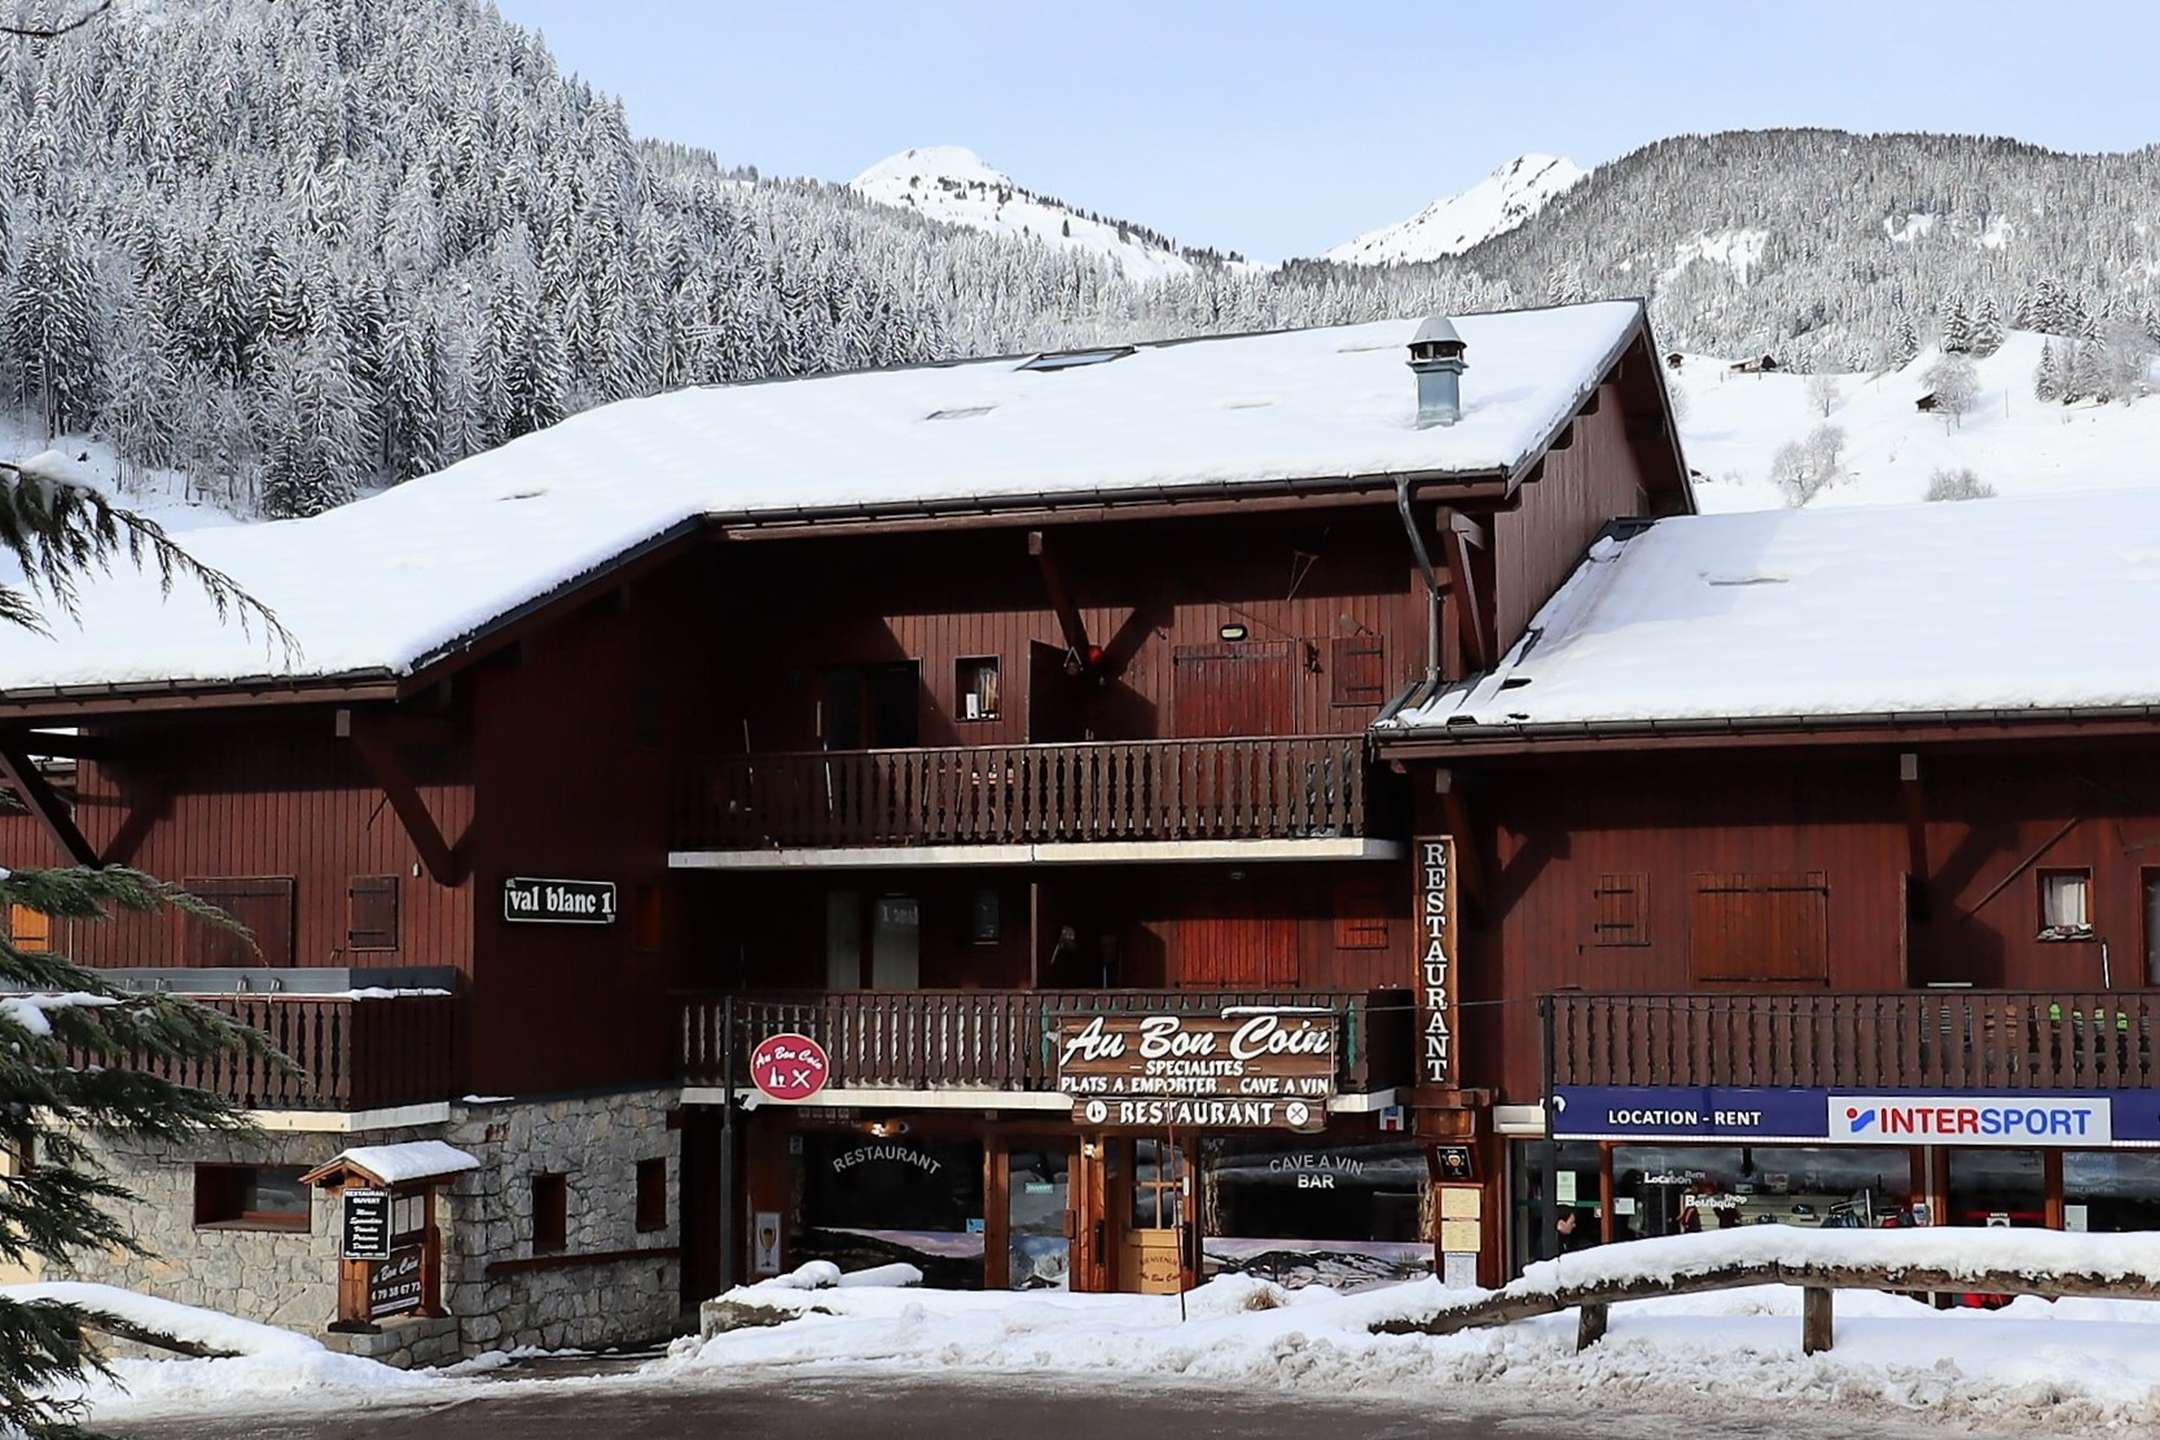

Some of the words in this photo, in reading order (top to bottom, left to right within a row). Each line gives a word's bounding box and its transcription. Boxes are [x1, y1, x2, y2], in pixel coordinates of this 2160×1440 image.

[509, 886, 539, 911] val
[545, 886, 596, 913] blanc
[602, 892, 612, 913] 1
[1423, 843, 1449, 1082] RESTAURANT
[1060, 1016, 1126, 1066] Au
[1140, 1016, 1217, 1059] Bon
[1229, 1015, 1330, 1060] Coin
[756, 1052, 771, 1069] Au
[775, 1046, 796, 1060] Bon
[1145, 1060, 1244, 1076] SPECIALITES
[1060, 1077, 1108, 1092] PLATS
[1112, 1077, 1124, 1093] A
[1131, 1077, 1217, 1093] EMPORTER
[1240, 1078, 1279, 1094] CAVE
[1284, 1078, 1295, 1094] A
[1300, 1078, 1329, 1094] VIN
[1120, 1101, 1275, 1125] RESTAURANT
[1608, 1110, 1697, 1125] LOCATION
[1714, 1111, 1762, 1126] RENT
[1881, 1107, 2092, 1135] INTERSPORT
[832, 1145, 942, 1174] RESTAURANT
[1270, 1154, 1314, 1173] CAVE
[1319, 1155, 1330, 1168] A
[1336, 1156, 1363, 1175] VIN
[1298, 1174, 1335, 1189] BAR
